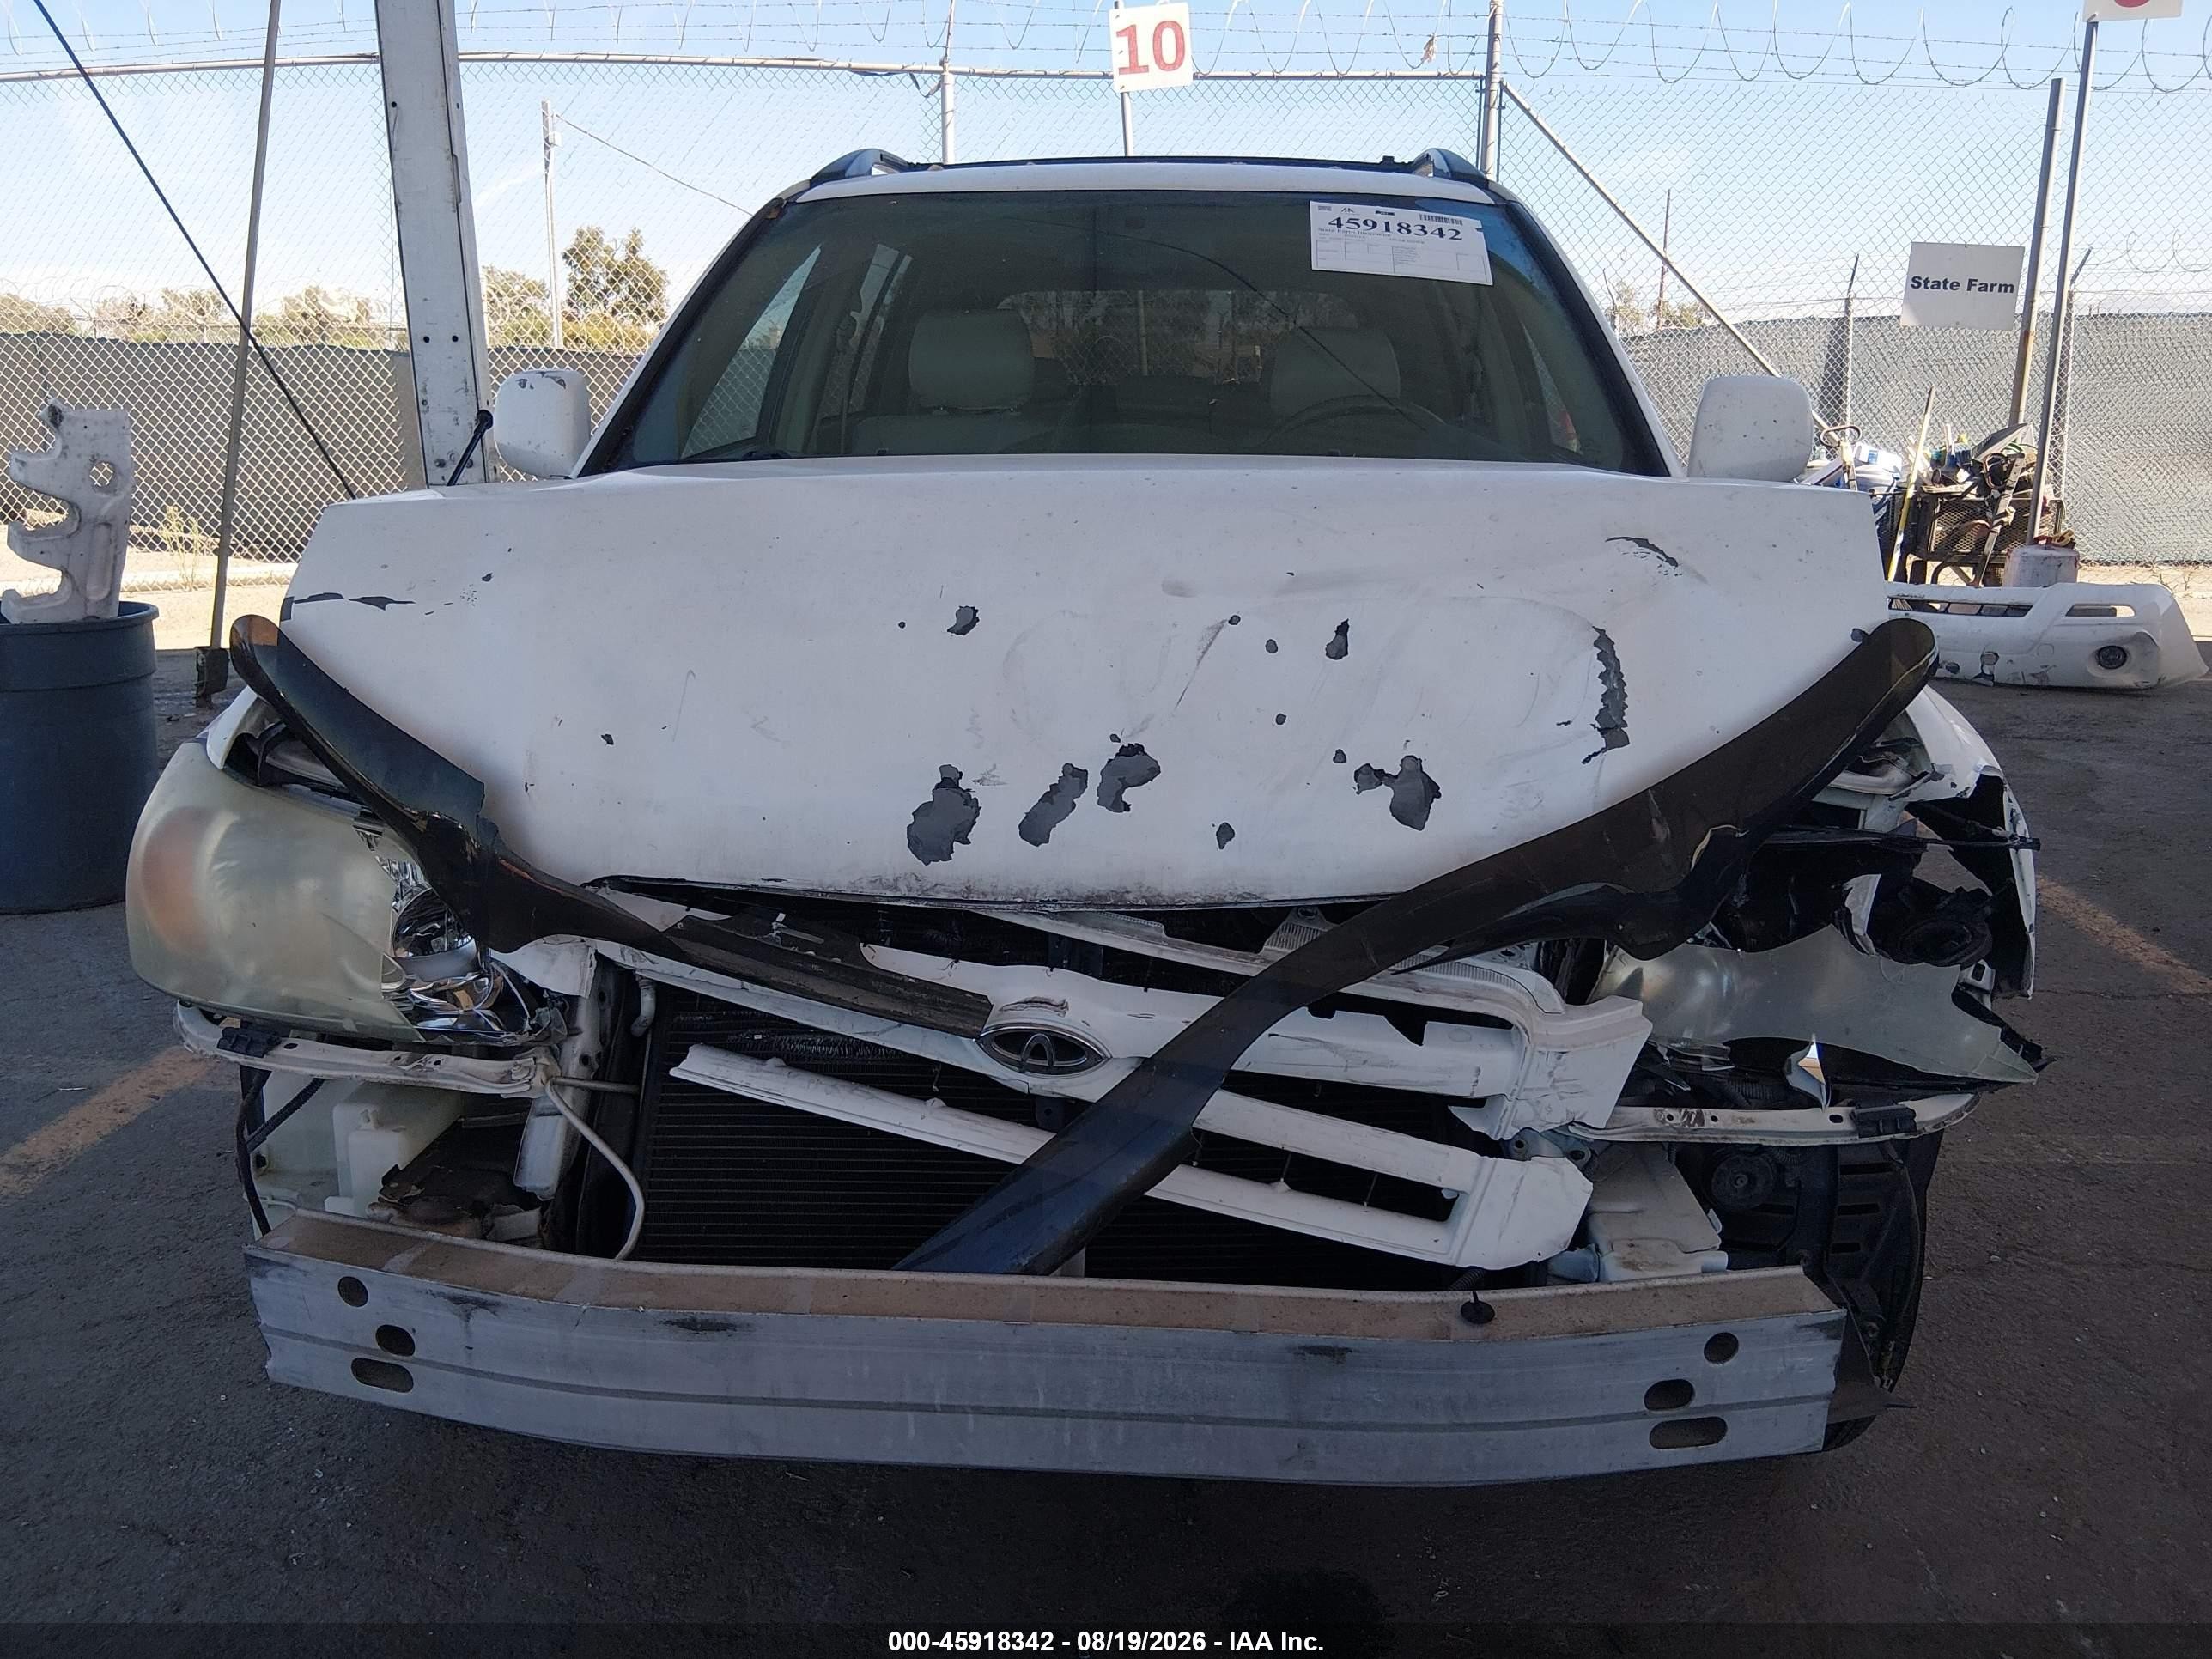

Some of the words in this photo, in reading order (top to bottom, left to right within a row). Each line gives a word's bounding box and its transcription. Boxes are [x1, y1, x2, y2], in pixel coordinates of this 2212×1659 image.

[1115, 20, 1186, 76] 10
[1328, 216, 1463, 241] 45918342
[1910, 276, 1960, 291] State
[1966, 278, 2014, 294] Farm
